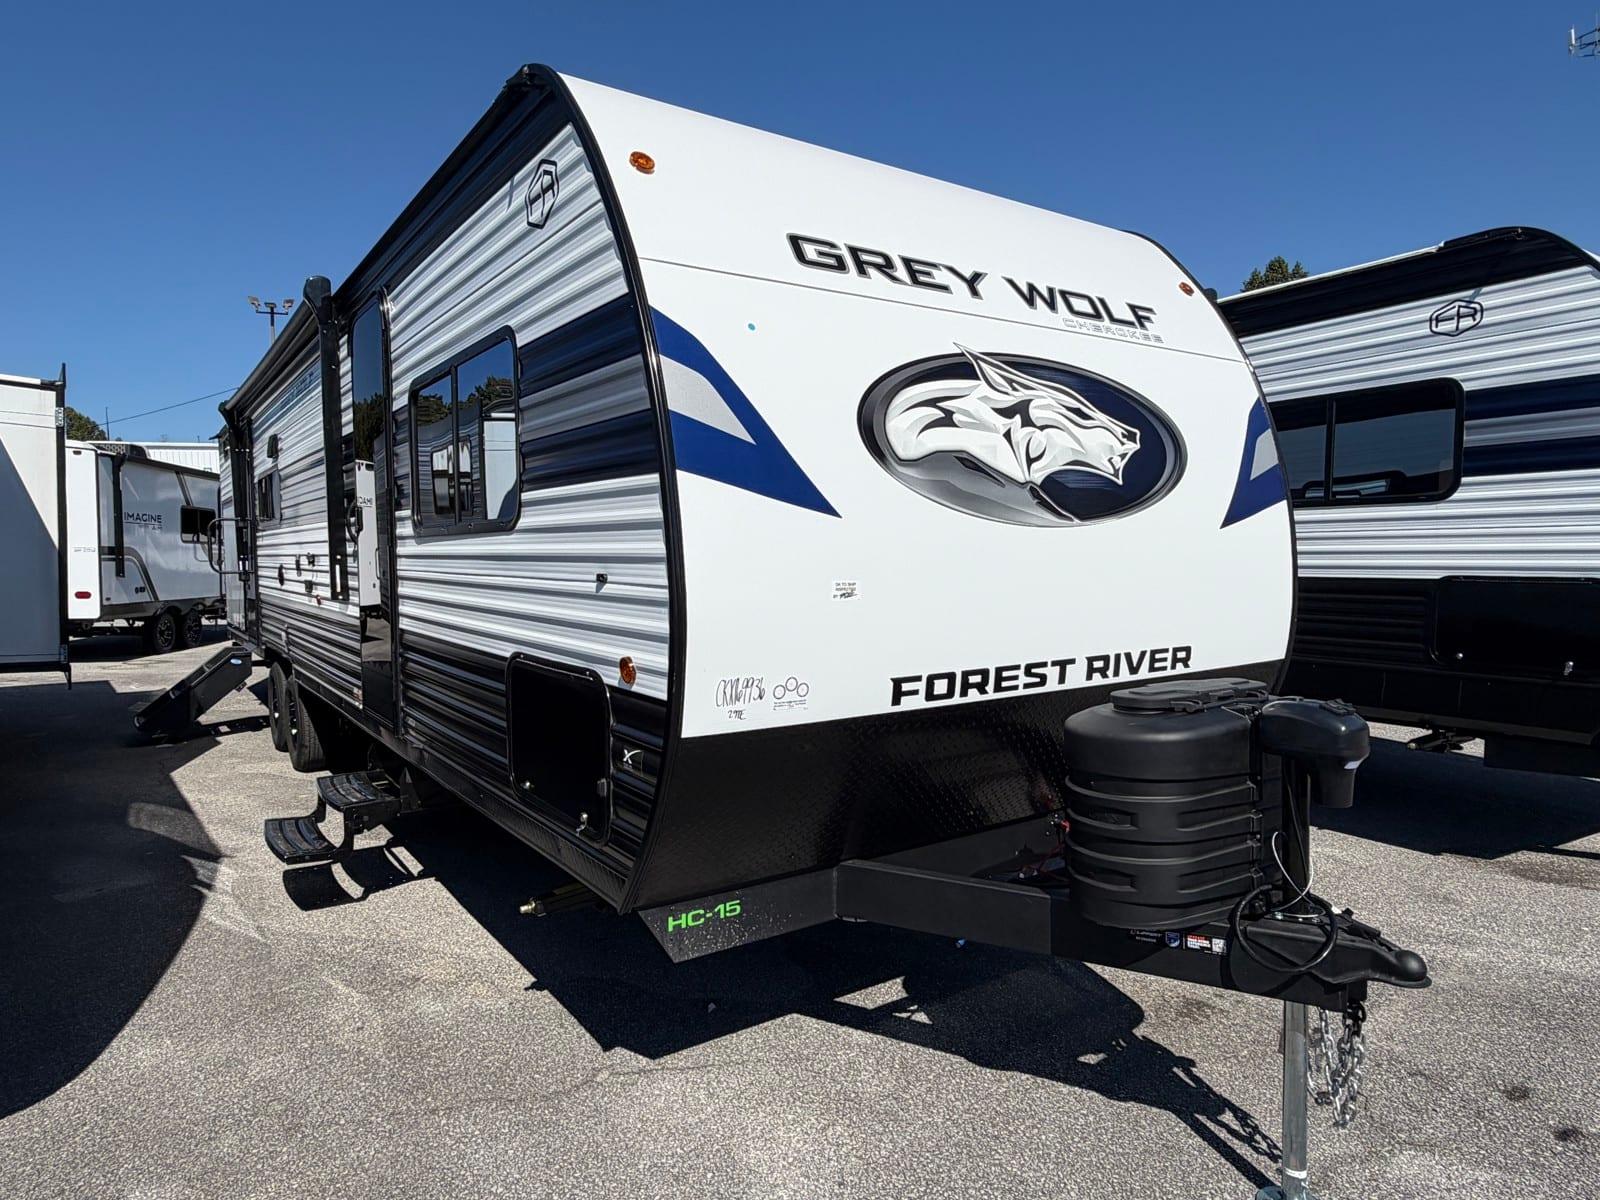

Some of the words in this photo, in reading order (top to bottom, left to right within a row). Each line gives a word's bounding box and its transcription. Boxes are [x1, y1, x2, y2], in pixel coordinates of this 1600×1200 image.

[786, 232, 988, 300] GREY
[1003, 276, 1158, 331] WOLF
[1063, 317, 1164, 344] CHEROKEE
[124, 511, 162, 524] IMAGINE
[890, 658, 1076, 707] FOREST
[1085, 645, 1192, 682] RIVER
[667, 899, 742, 932] HC-15
